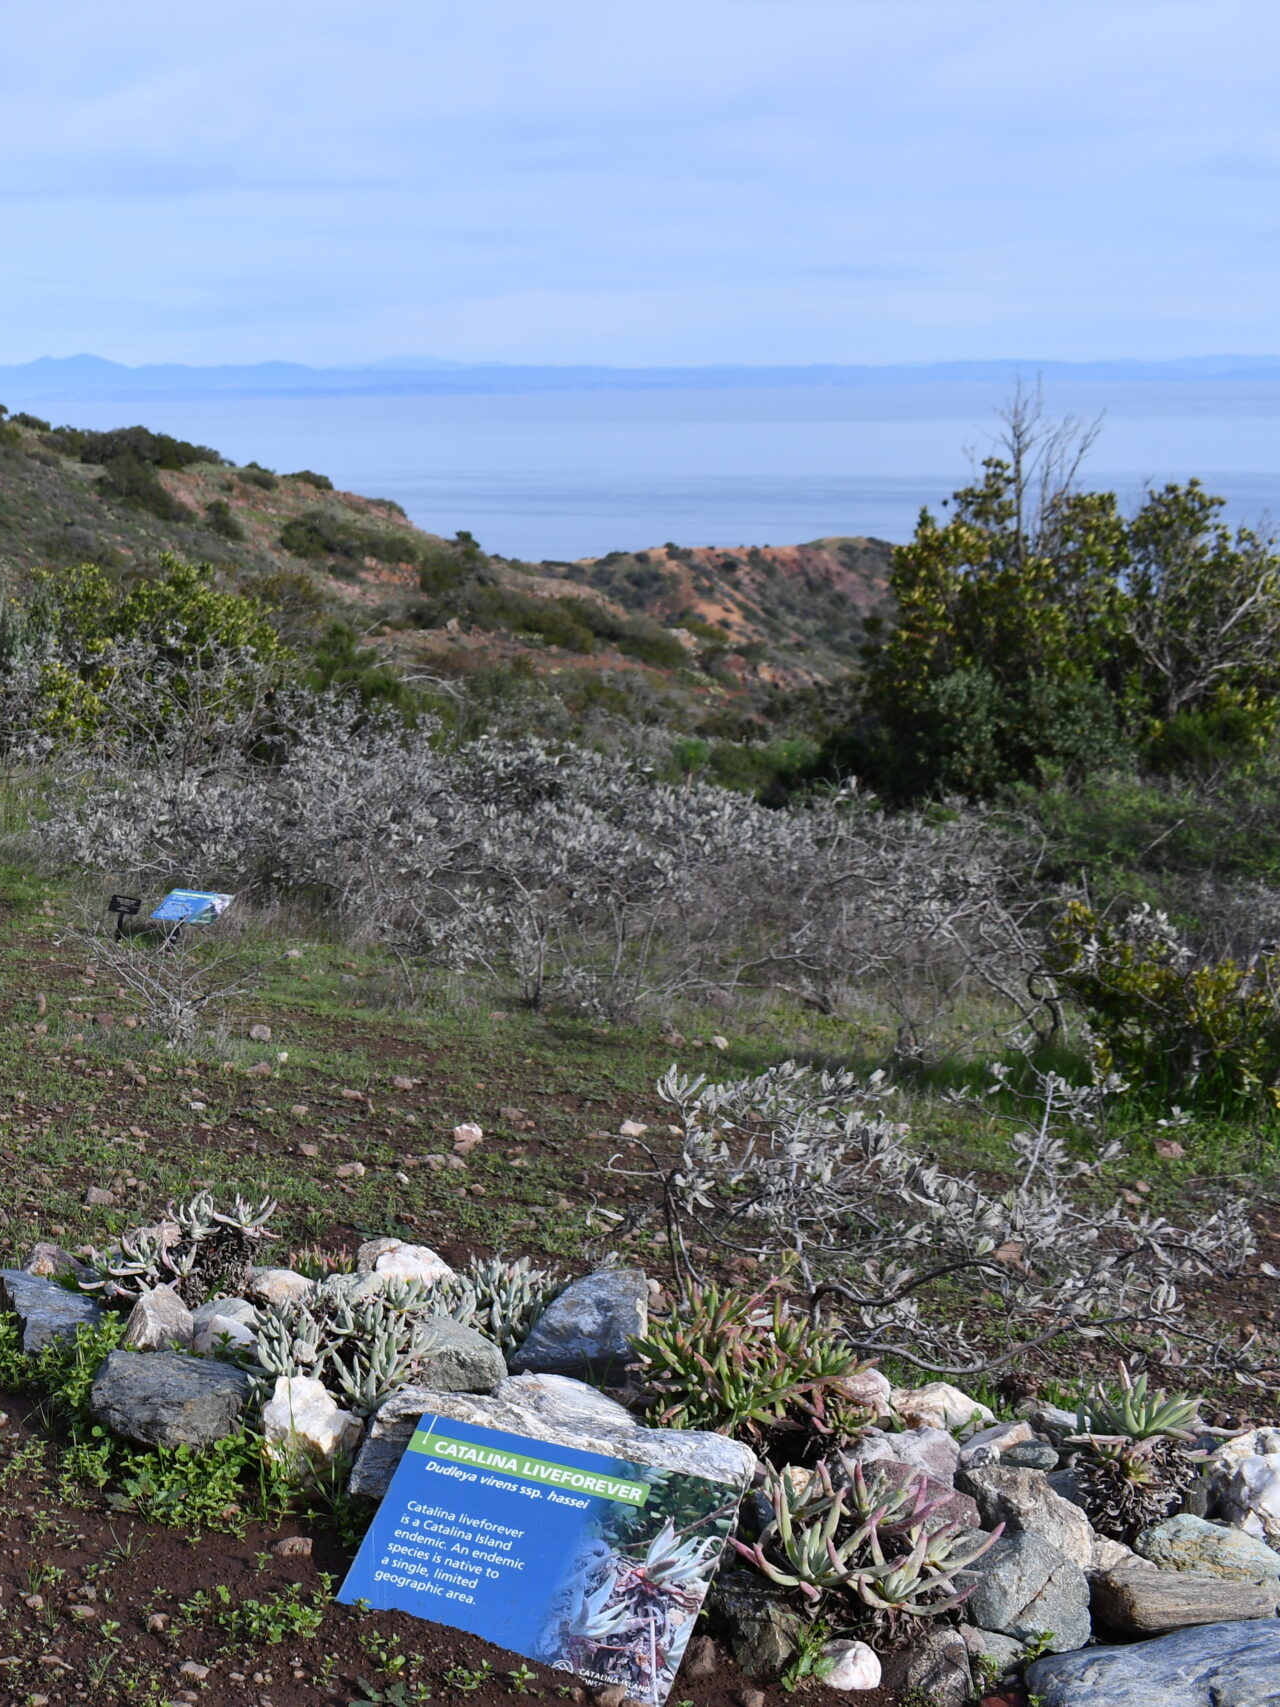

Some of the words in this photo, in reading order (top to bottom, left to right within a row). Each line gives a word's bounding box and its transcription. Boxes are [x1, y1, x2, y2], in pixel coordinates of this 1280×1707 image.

[425, 1461, 478, 1482] Dudleya
[480, 1475, 518, 1492] virens
[519, 1486, 543, 1499] ssp.
[547, 1490, 590, 1509] hassei
[434, 1441, 518, 1472] CATALINA
[522, 1462, 642, 1501] LIVEFOREVER
[400, 1514, 410, 1524] is
[412, 1518, 420, 1526] a
[423, 1520, 472, 1540] Catalina
[475, 1533, 512, 1551] Island
[407, 1501, 456, 1521] Catalina
[458, 1514, 525, 1538] liveforever
[387, 1542, 430, 1560] species
[432, 1552, 442, 1564] is
[444, 1560, 483, 1575] native
[486, 1567, 500, 1579] to
[394, 1529, 446, 1550] endemic.
[450, 1543, 470, 1555] An
[472, 1548, 526, 1570] endemic
[374, 1570, 444, 1596] geographic
[446, 1590, 476, 1605] area.
[381, 1556, 390, 1565] a
[392, 1558, 430, 1578] single,
[434, 1568, 478, 1589] limited
[579, 1668, 618, 1684] CATALINA
[621, 1680, 651, 1694] ISLAND
